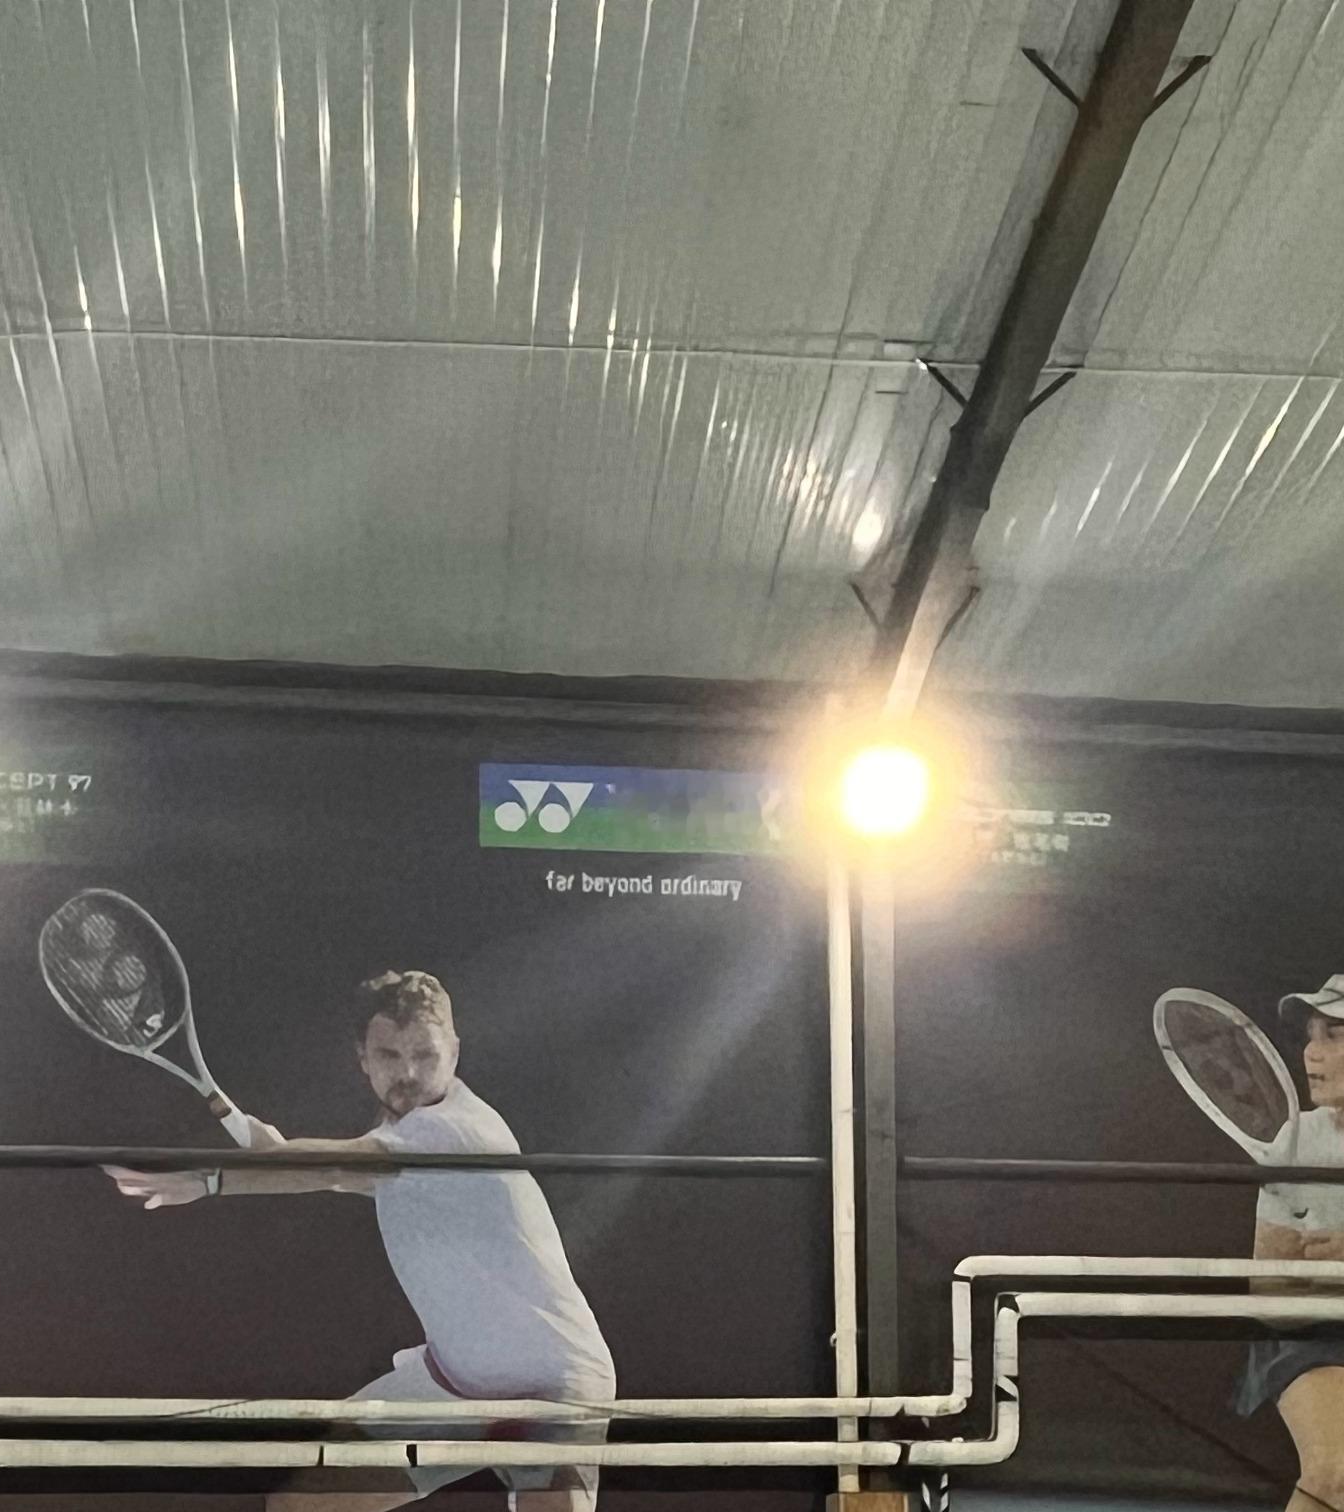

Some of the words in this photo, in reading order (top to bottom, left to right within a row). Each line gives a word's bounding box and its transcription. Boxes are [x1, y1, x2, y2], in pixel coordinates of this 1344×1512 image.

[545, 870, 575, 892] far
[582, 872, 653, 898] beyond
[660, 874, 743, 901] ordinary
